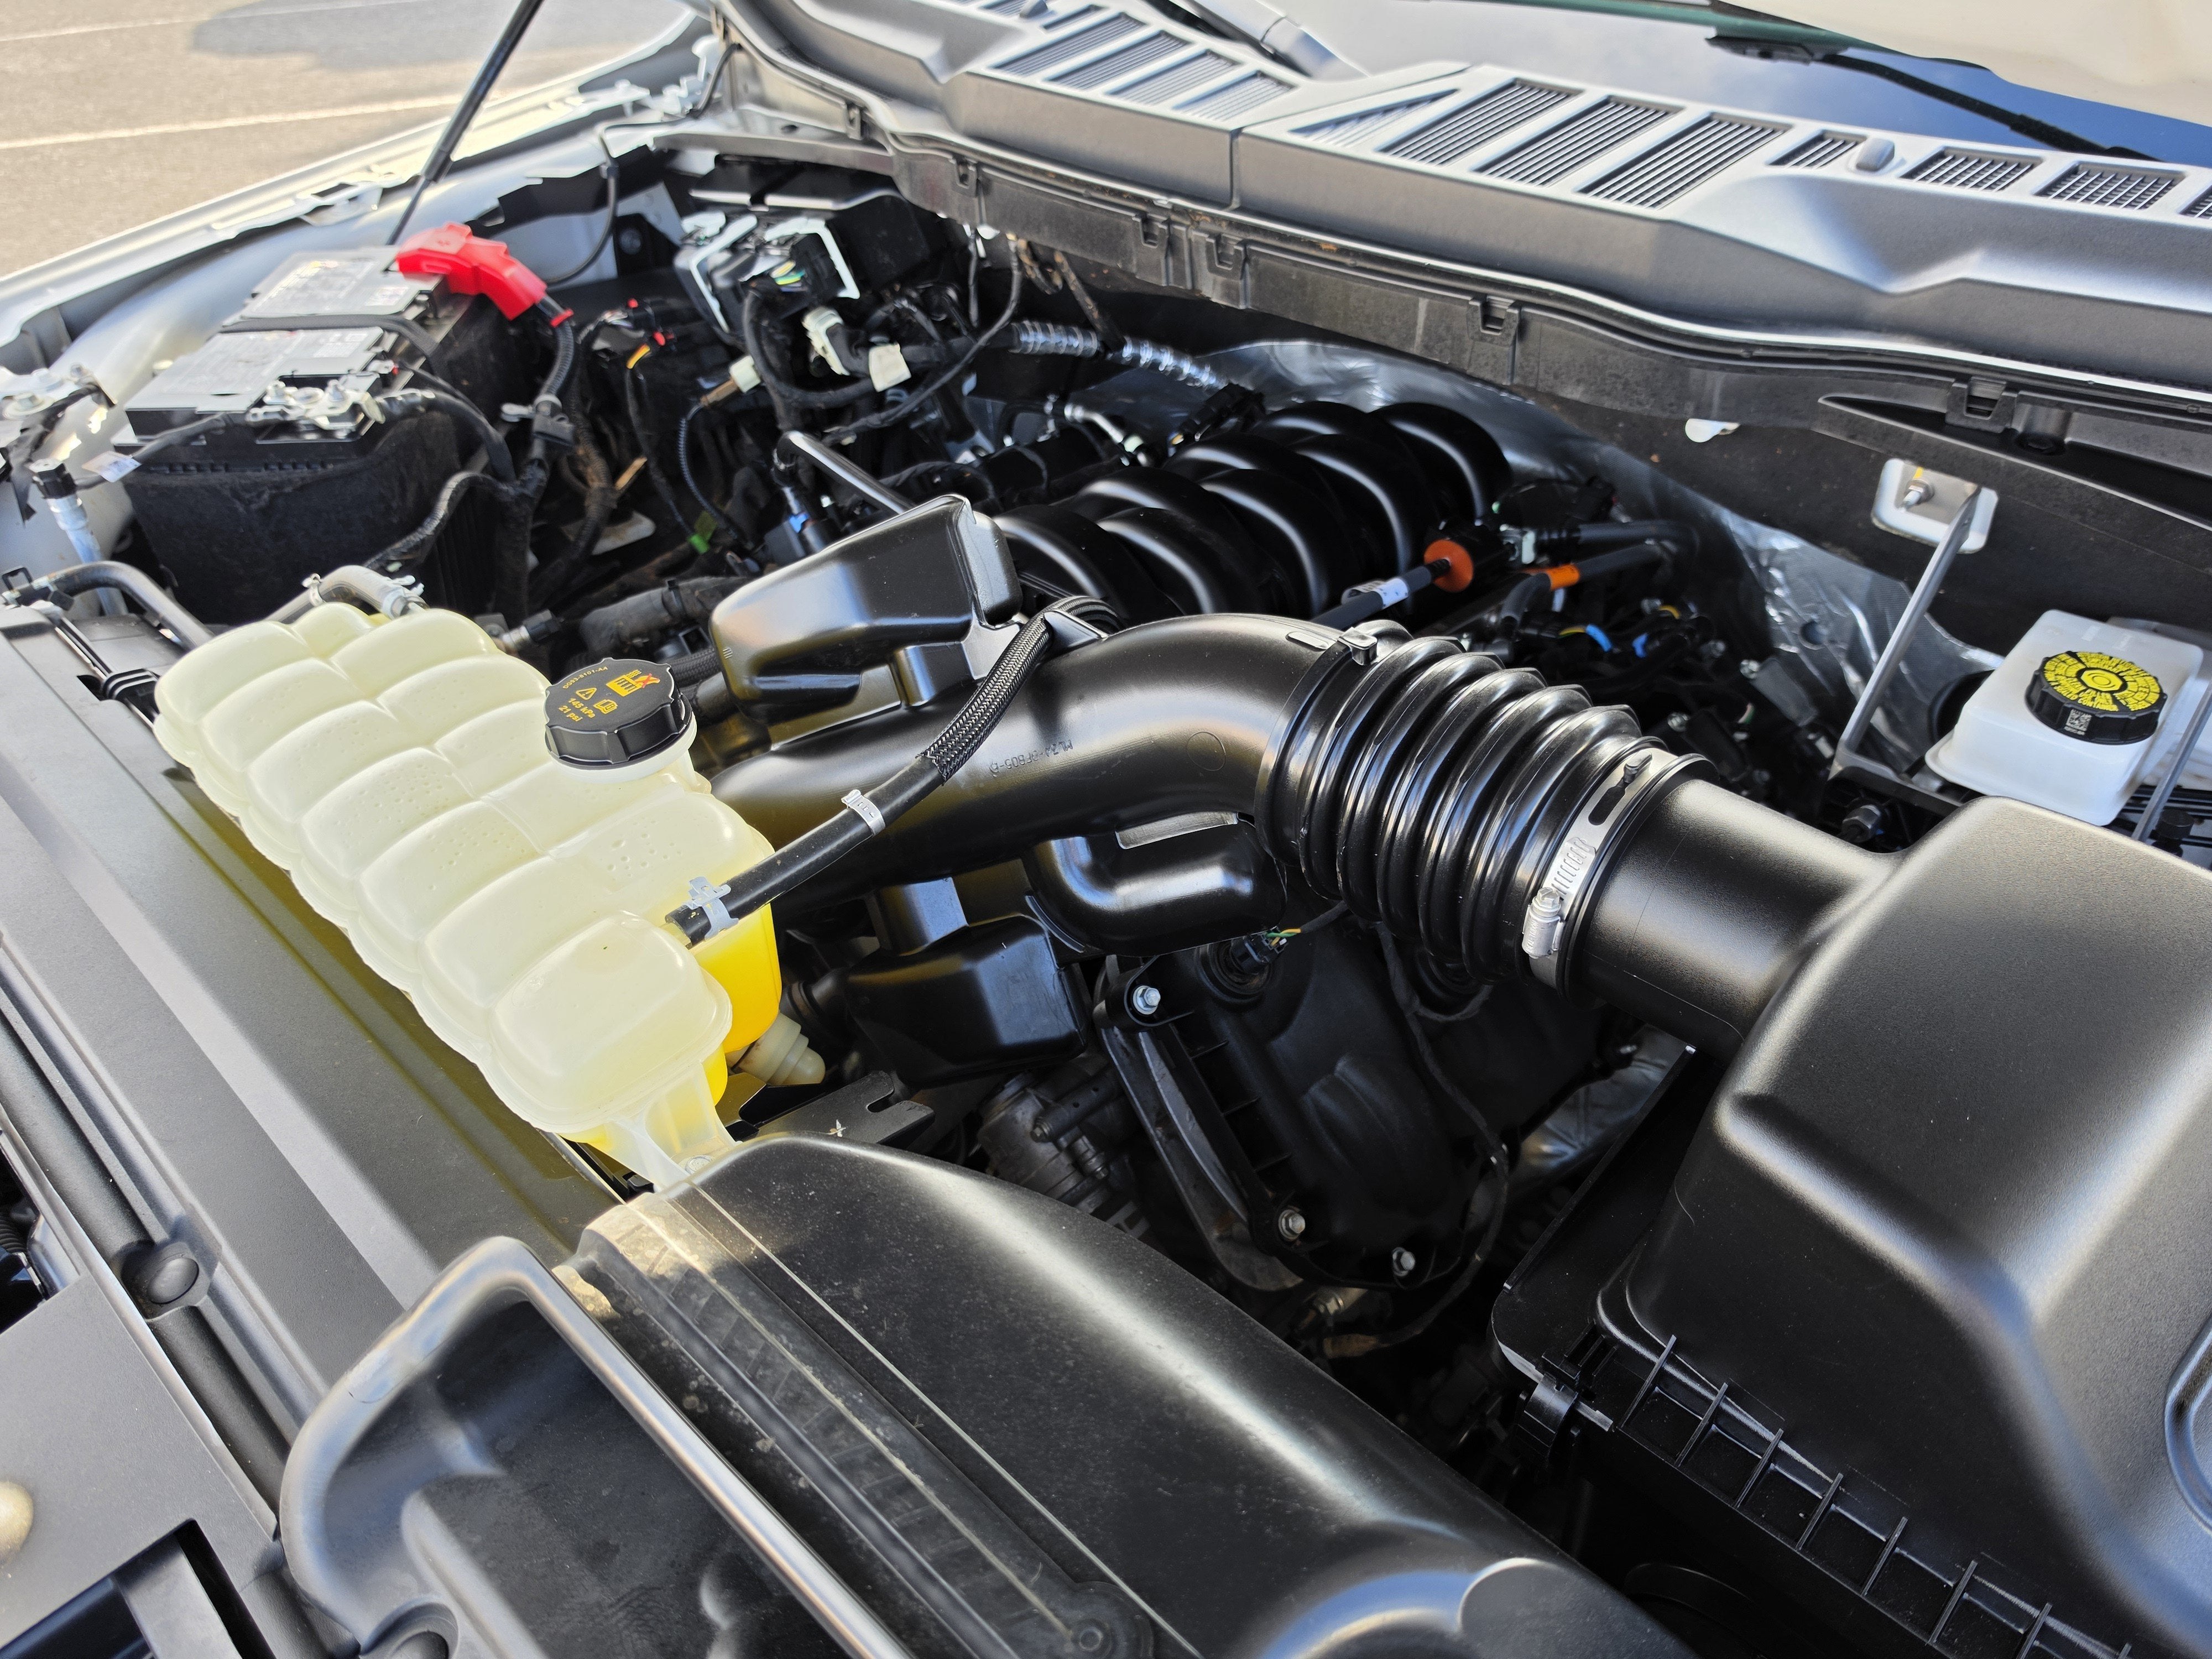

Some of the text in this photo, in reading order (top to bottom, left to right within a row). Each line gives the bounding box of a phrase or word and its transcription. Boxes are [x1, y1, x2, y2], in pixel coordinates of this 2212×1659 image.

[558, 705, 583, 722] 21 psi
[568, 698, 596, 718] 145 kPa
